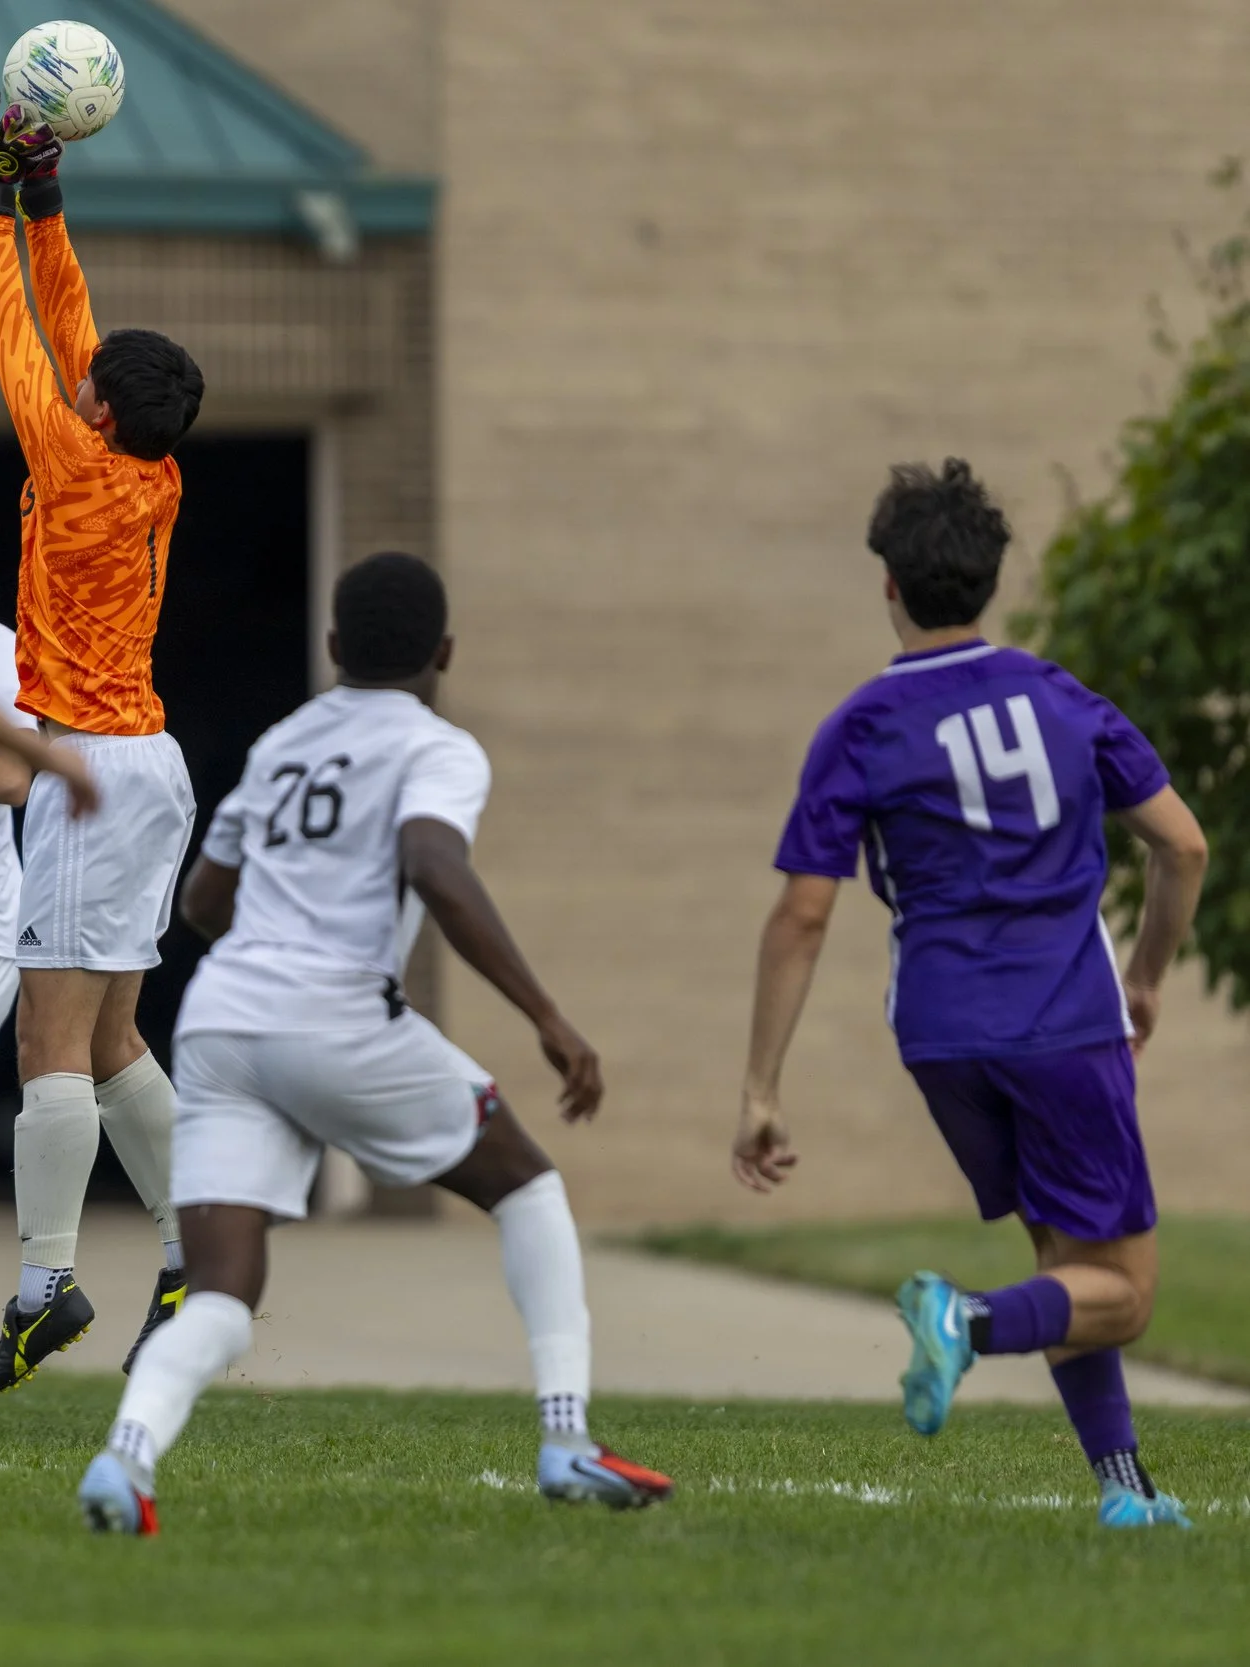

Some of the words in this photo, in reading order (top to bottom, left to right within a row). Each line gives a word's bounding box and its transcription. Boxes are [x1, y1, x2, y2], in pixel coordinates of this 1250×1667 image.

[263, 753, 352, 848] 26
[934, 693, 1062, 832] 14
[17, 938, 42, 947] adidas
